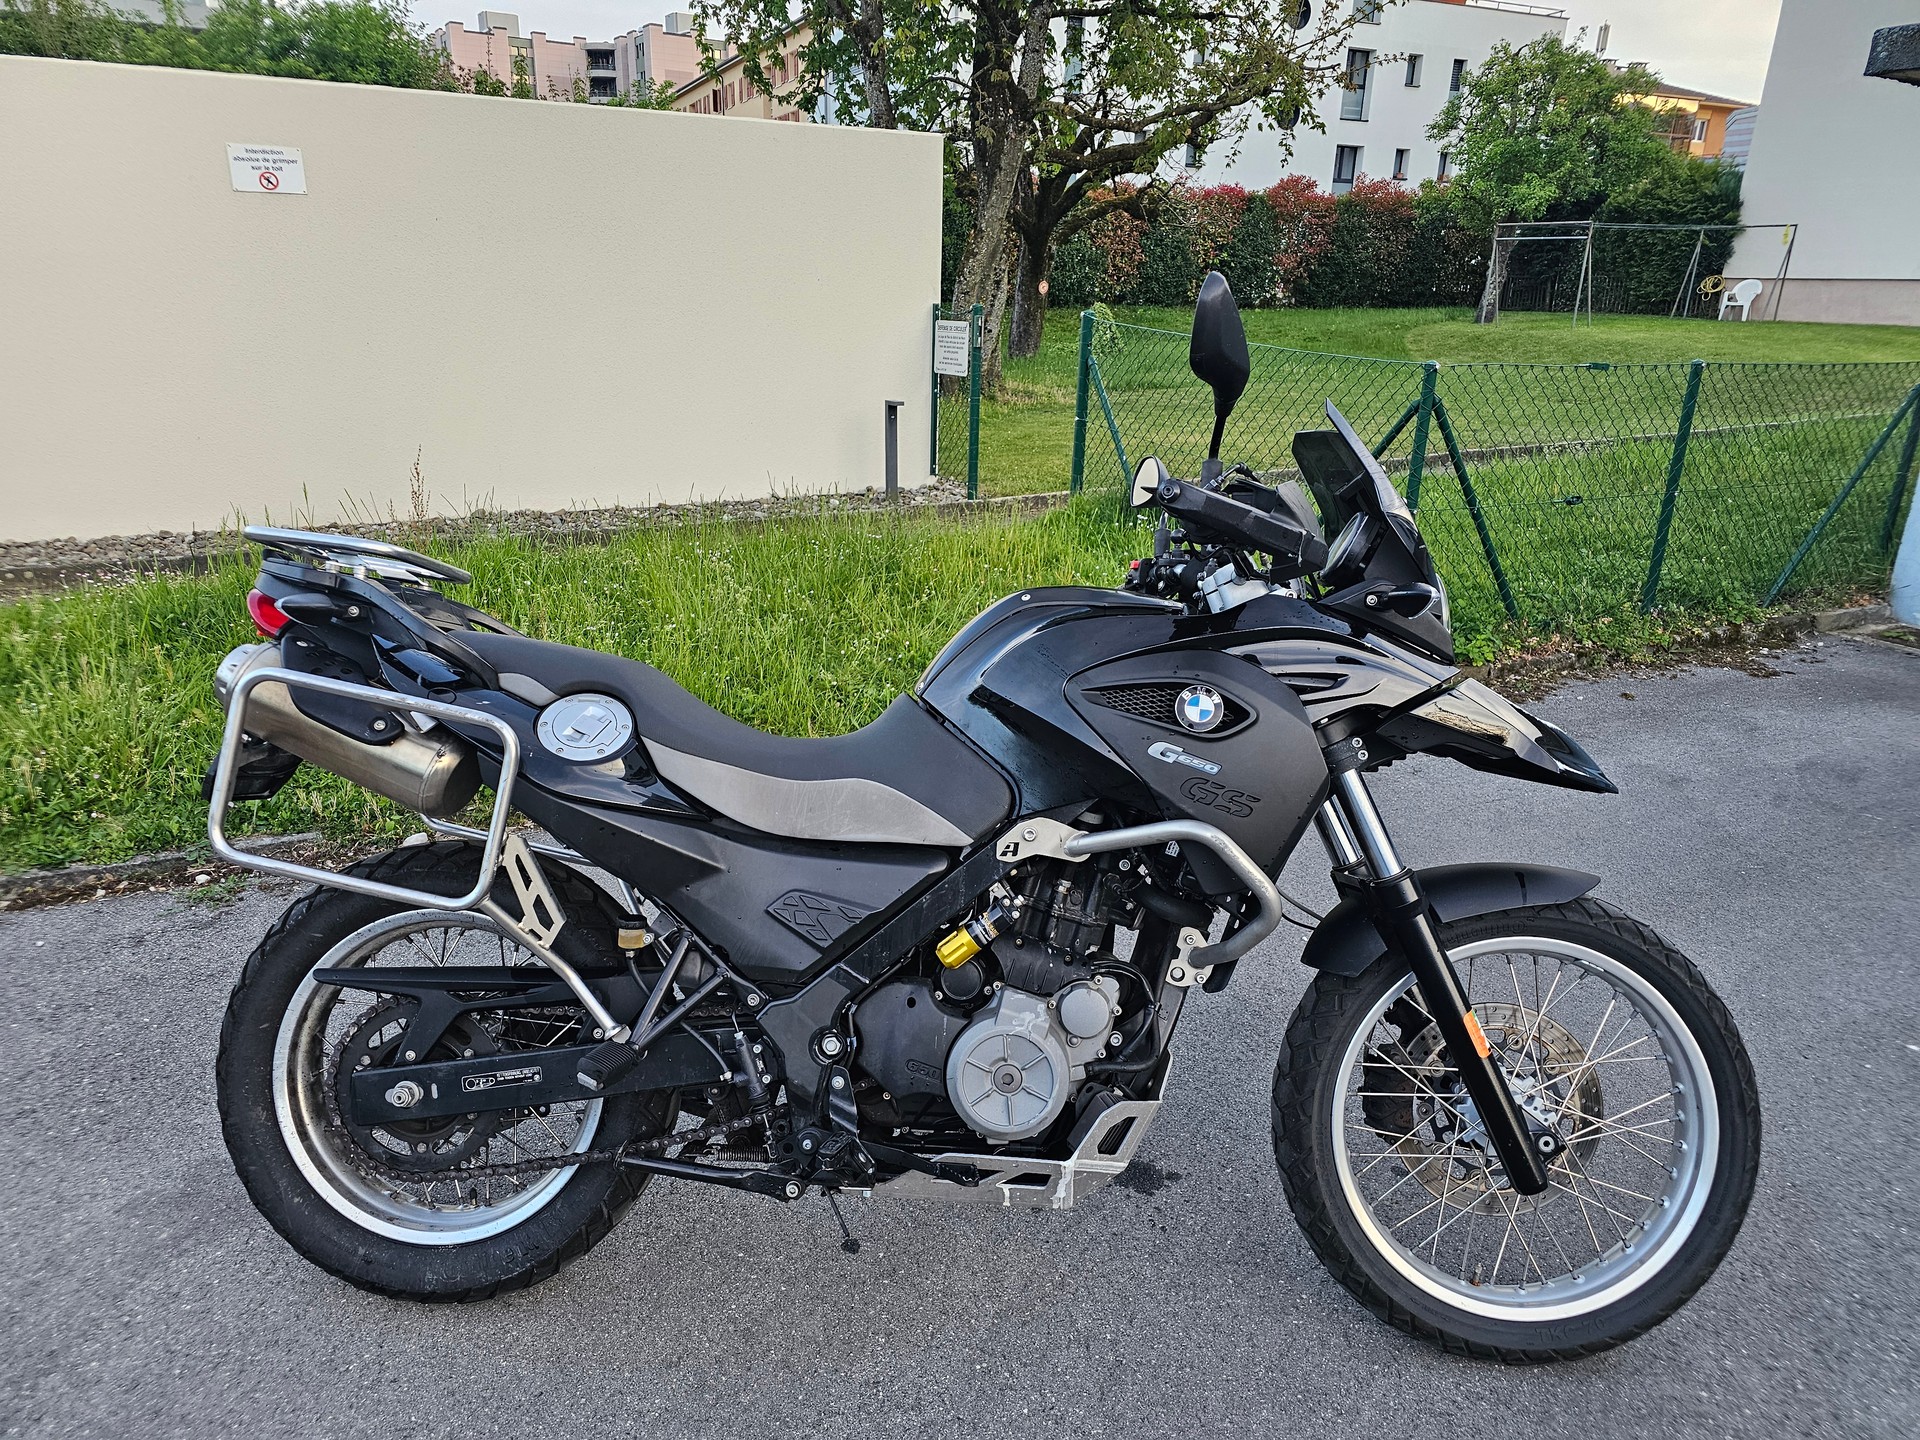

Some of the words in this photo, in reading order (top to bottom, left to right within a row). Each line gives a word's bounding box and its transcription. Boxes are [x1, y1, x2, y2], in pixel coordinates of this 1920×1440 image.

[244, 147, 284, 156] Interdiction
[233, 155, 260, 163] absolue
[272, 157, 298, 165] grimper
[1179, 777, 1262, 818] GS
[907, 1060, 939, 1079] 650
